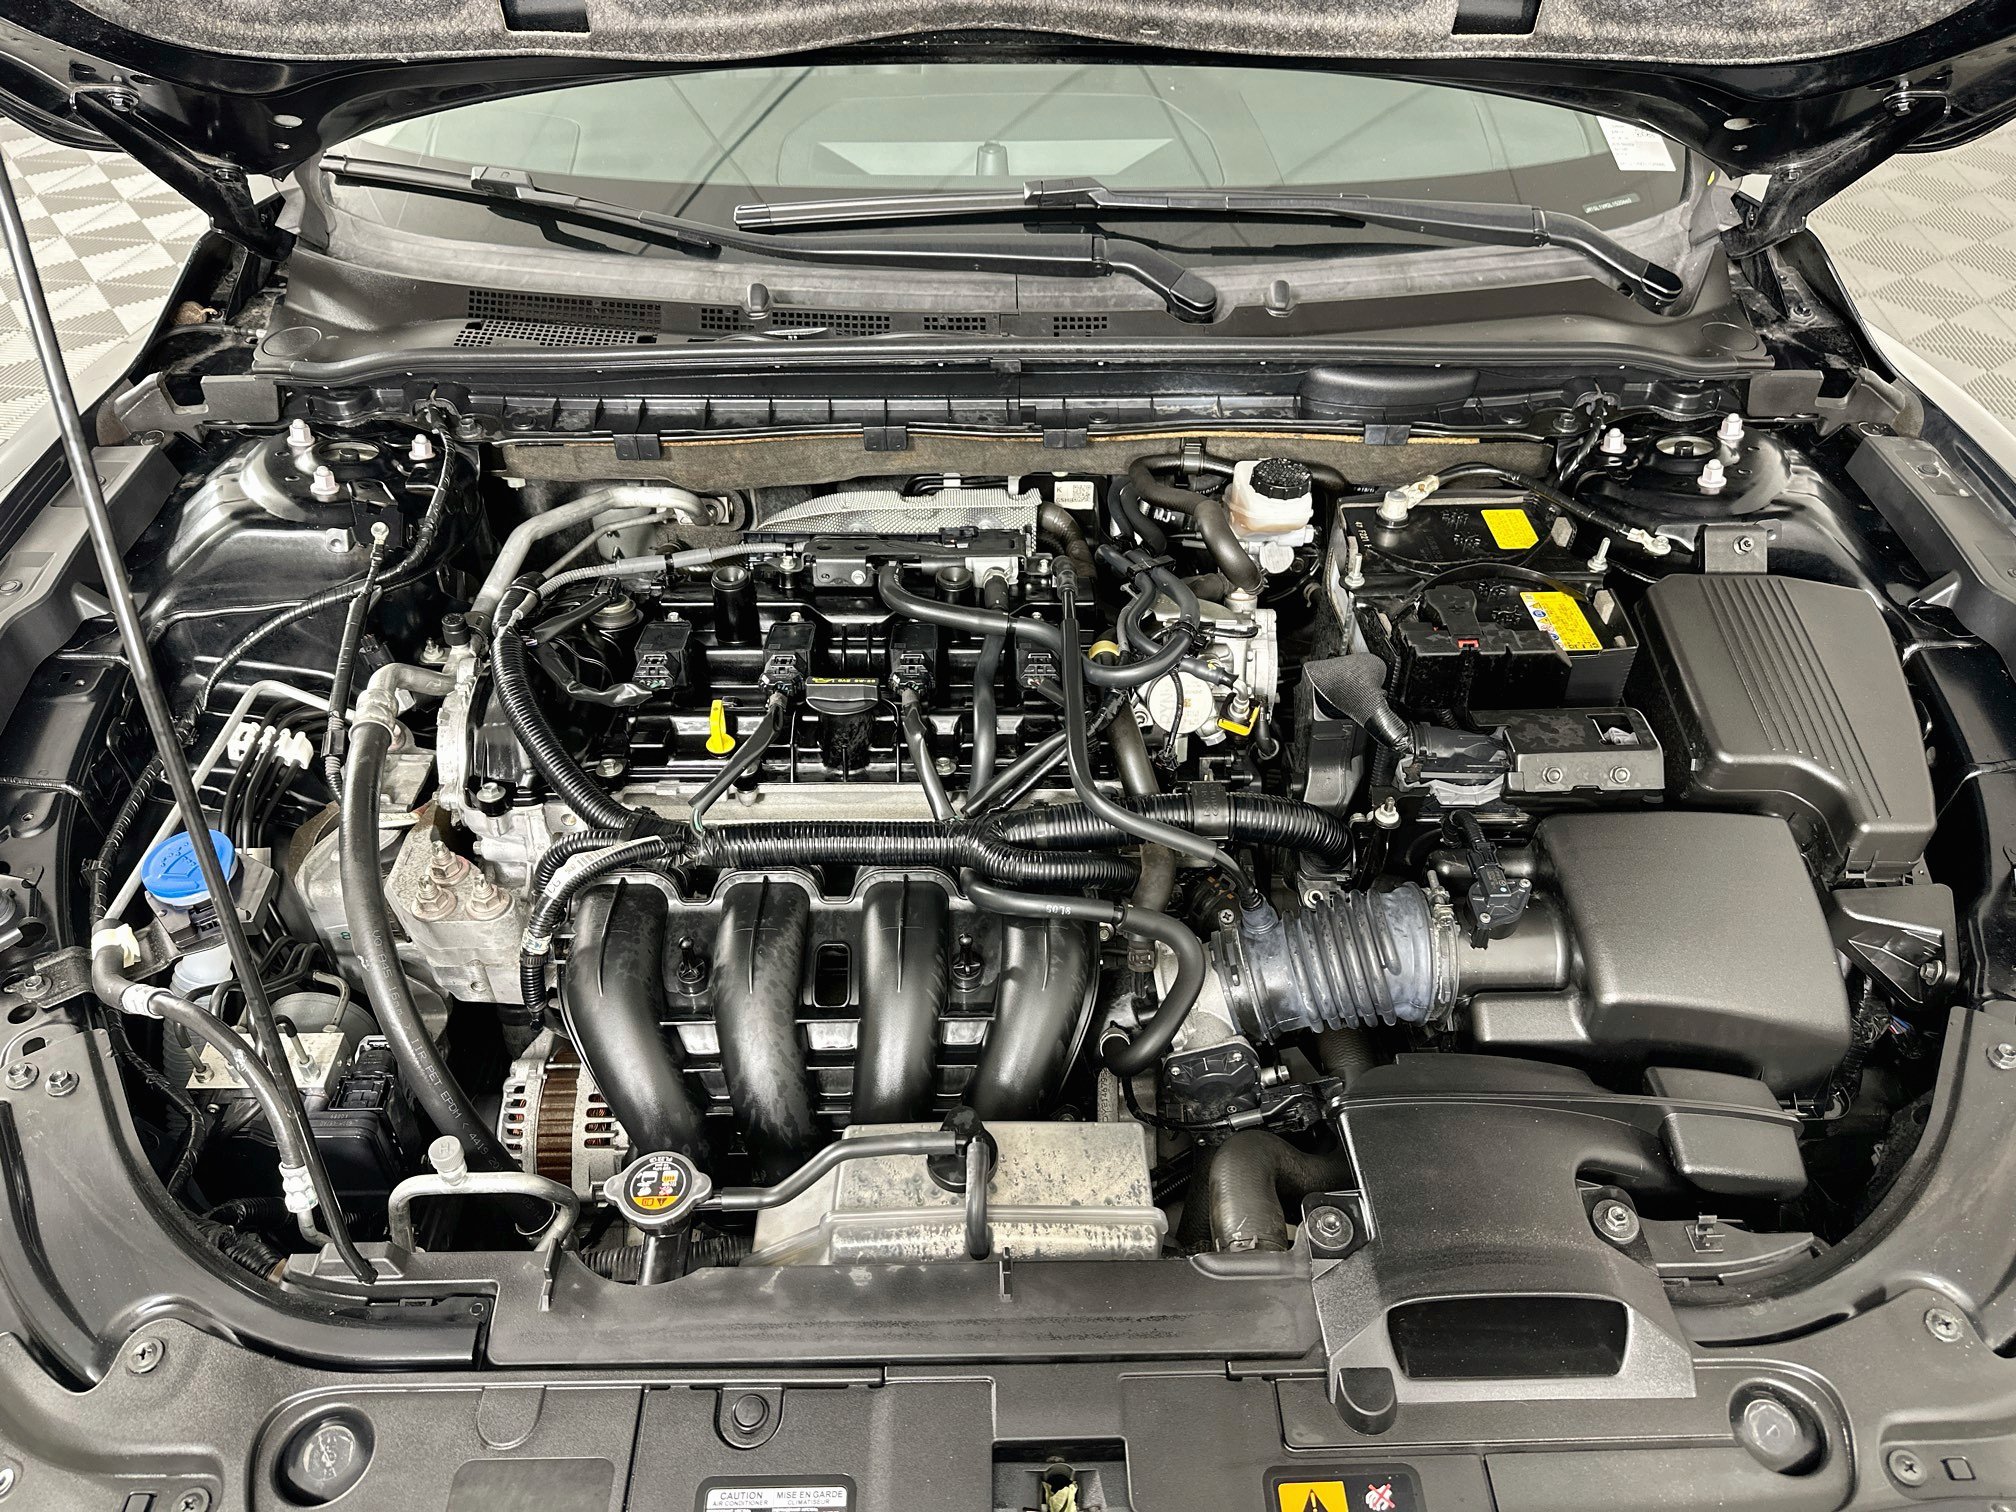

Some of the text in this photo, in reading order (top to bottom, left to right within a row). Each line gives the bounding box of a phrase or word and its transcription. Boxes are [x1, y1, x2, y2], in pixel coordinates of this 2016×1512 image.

[547, 878, 562, 894] CG
[425, 1064, 443, 1086] PET
[440, 1090, 463, 1119] EPDM
[468, 1133, 489, 1155] 4419
[439, 1142, 450, 1154] H
[720, 1491, 763, 1500] CAUTION
[776, 1490, 843, 1499] MISE EN GARDE
